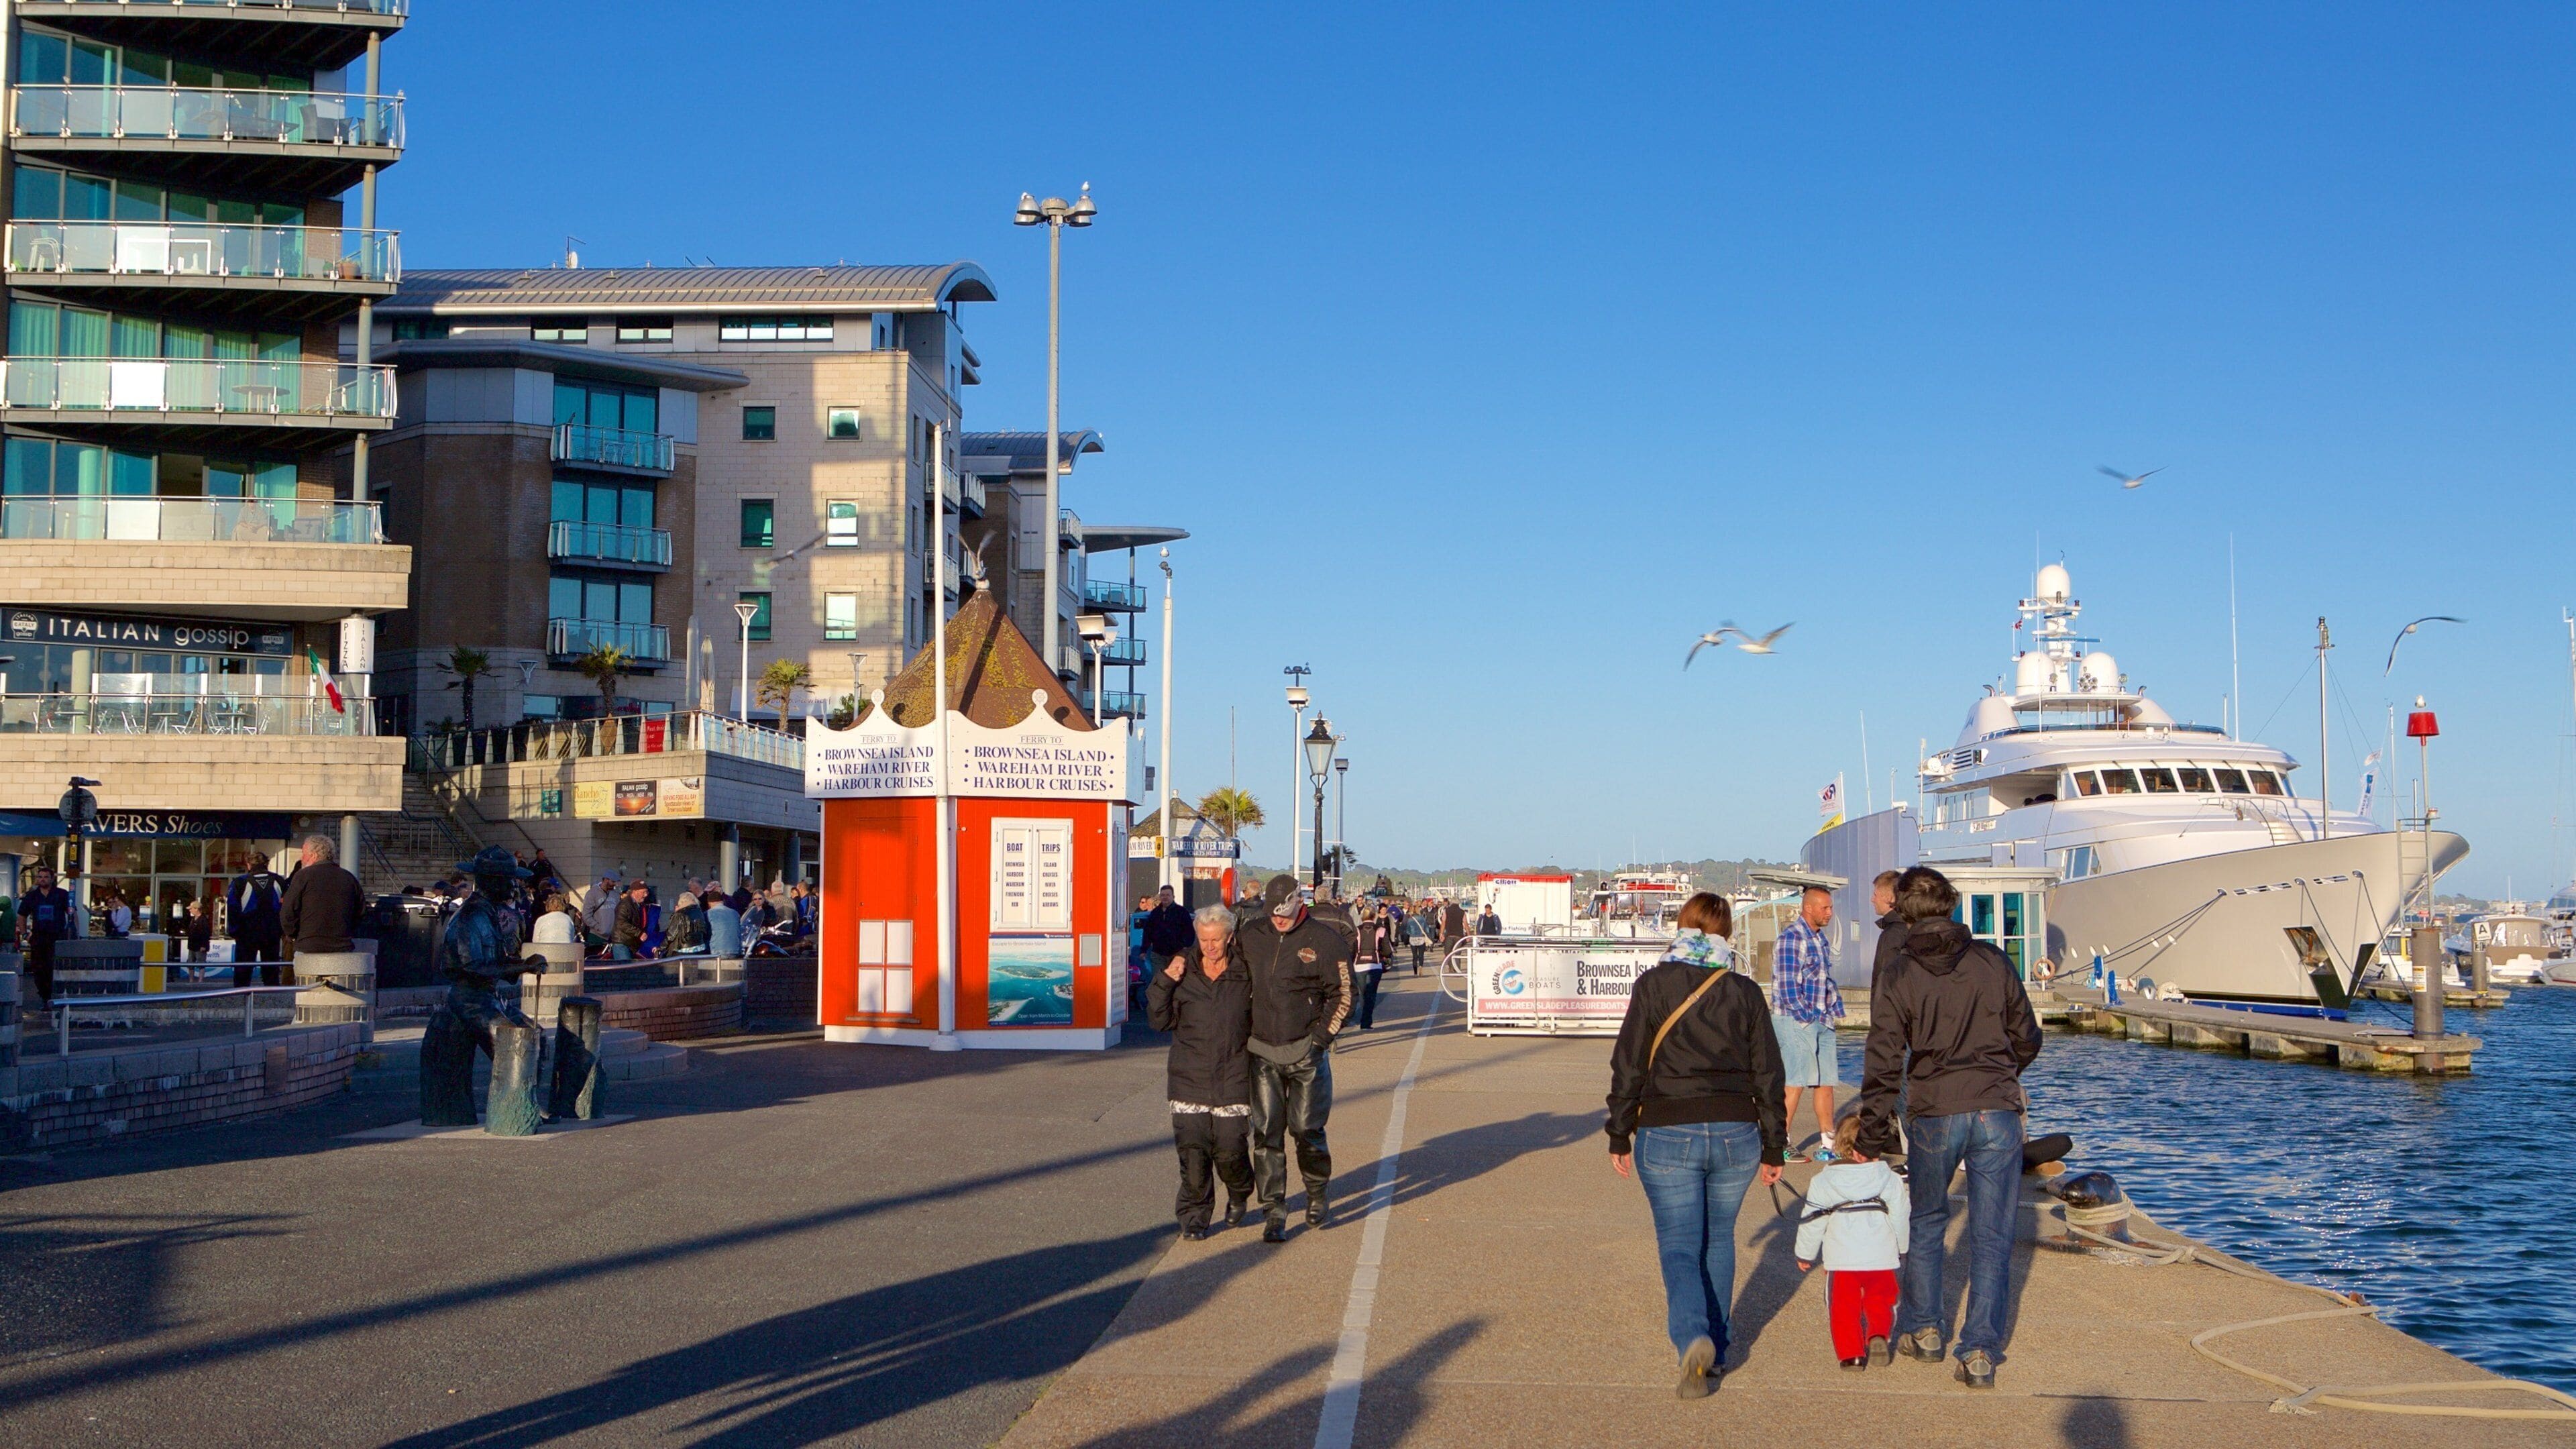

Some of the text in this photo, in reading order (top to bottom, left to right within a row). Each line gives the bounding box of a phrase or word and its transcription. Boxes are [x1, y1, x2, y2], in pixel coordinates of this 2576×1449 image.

[48, 618, 249, 649] ITALIAN gossip
[1020, 736, 1062, 744] FERRY TO
[824, 746, 934, 760] BROWNSEA ISLAND
[974, 746, 1106, 762] BROWNSEA ISLAND
[828, 761, 930, 775] WAREHAM RIVER
[978, 761, 1102, 777] WAREHAM RIVER
[824, 776, 934, 790] HARBOUR CRUISES
[974, 777, 1107, 792] HARBOUR CRUISES
[68, 814, 223, 834] AVERS Shoes
[1007, 843, 1061, 852] BOAT TRIPS
[1138, 841, 1153, 850] RIVER
[1171, 841, 1234, 851] WAREHAM RIVER TRIPS
[2479, 924, 2487, 934] A
[1493, 960, 1515, 995] GREENSLADE
[1577, 978, 1587, 996] &
[1485, 1001, 1629, 1010] WWW.GREENSLADEPLEASUREBOATS.
